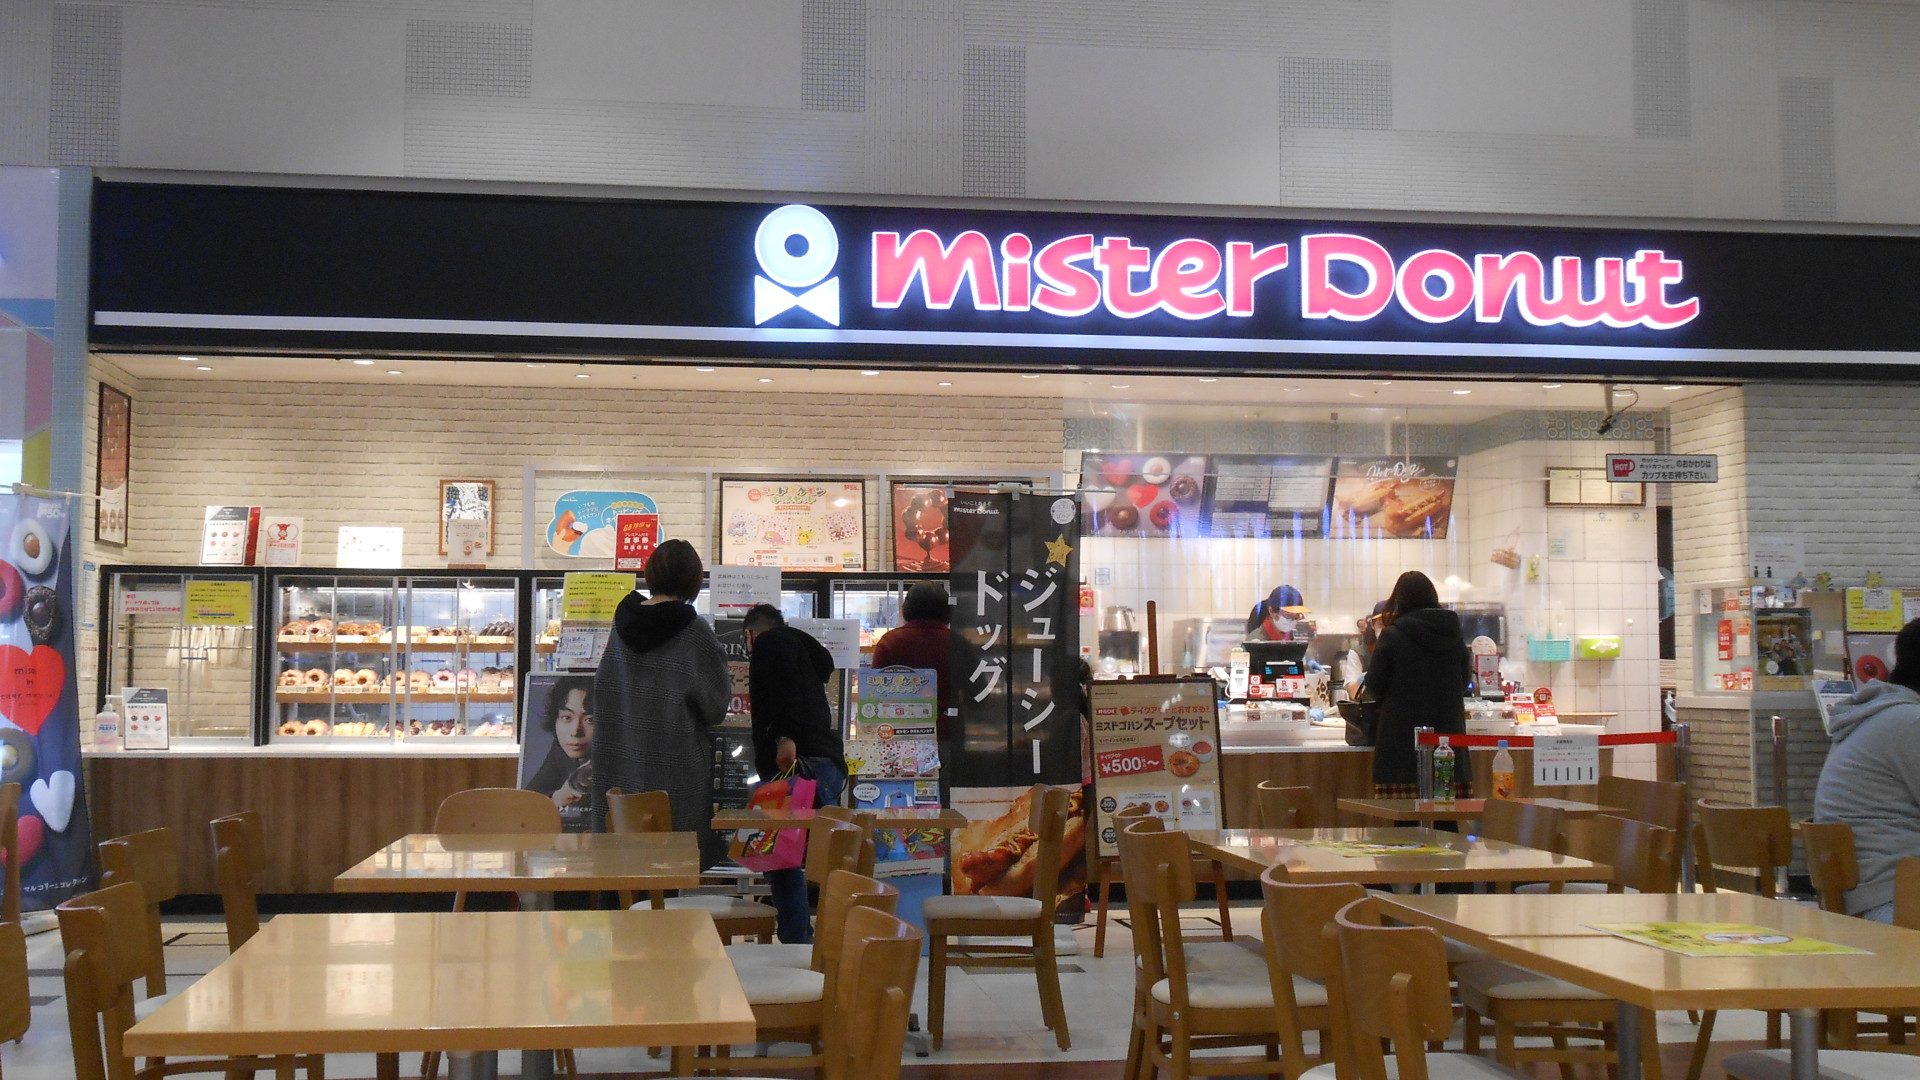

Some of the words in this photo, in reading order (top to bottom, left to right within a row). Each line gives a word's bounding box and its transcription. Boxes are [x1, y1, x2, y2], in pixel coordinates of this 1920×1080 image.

[1300, 232, 1701, 331] Donut
[1676, 460, 1712, 468] のおかわりは
[969, 569, 1009, 703] ドッグ
[1020, 566, 1058, 774] ジューシー
[1101, 757, 1142, 775] ¥500
